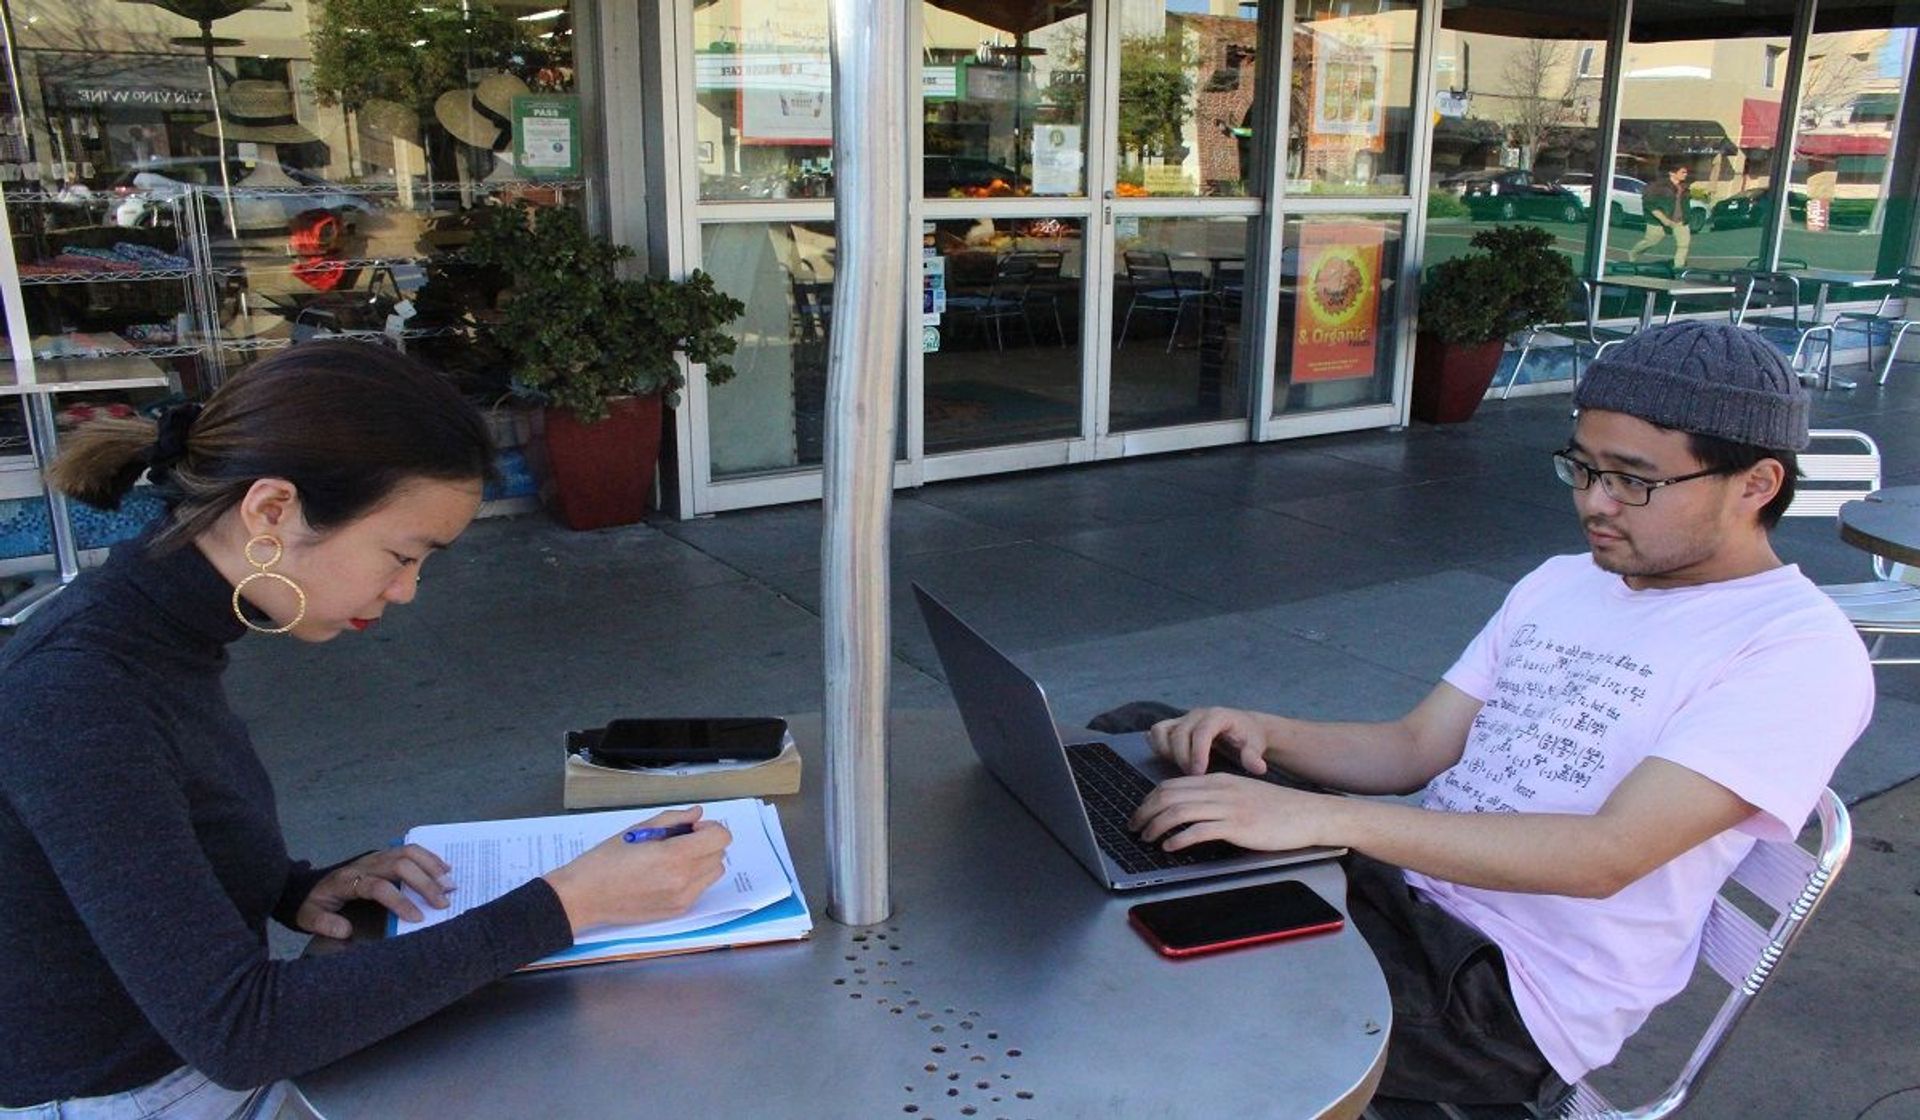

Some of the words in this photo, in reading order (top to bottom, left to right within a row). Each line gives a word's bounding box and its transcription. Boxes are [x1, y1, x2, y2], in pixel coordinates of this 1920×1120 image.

[533, 109, 559, 117] PASS
[1298, 329, 1309, 346] &
[1311, 328, 1366, 347] Organic
